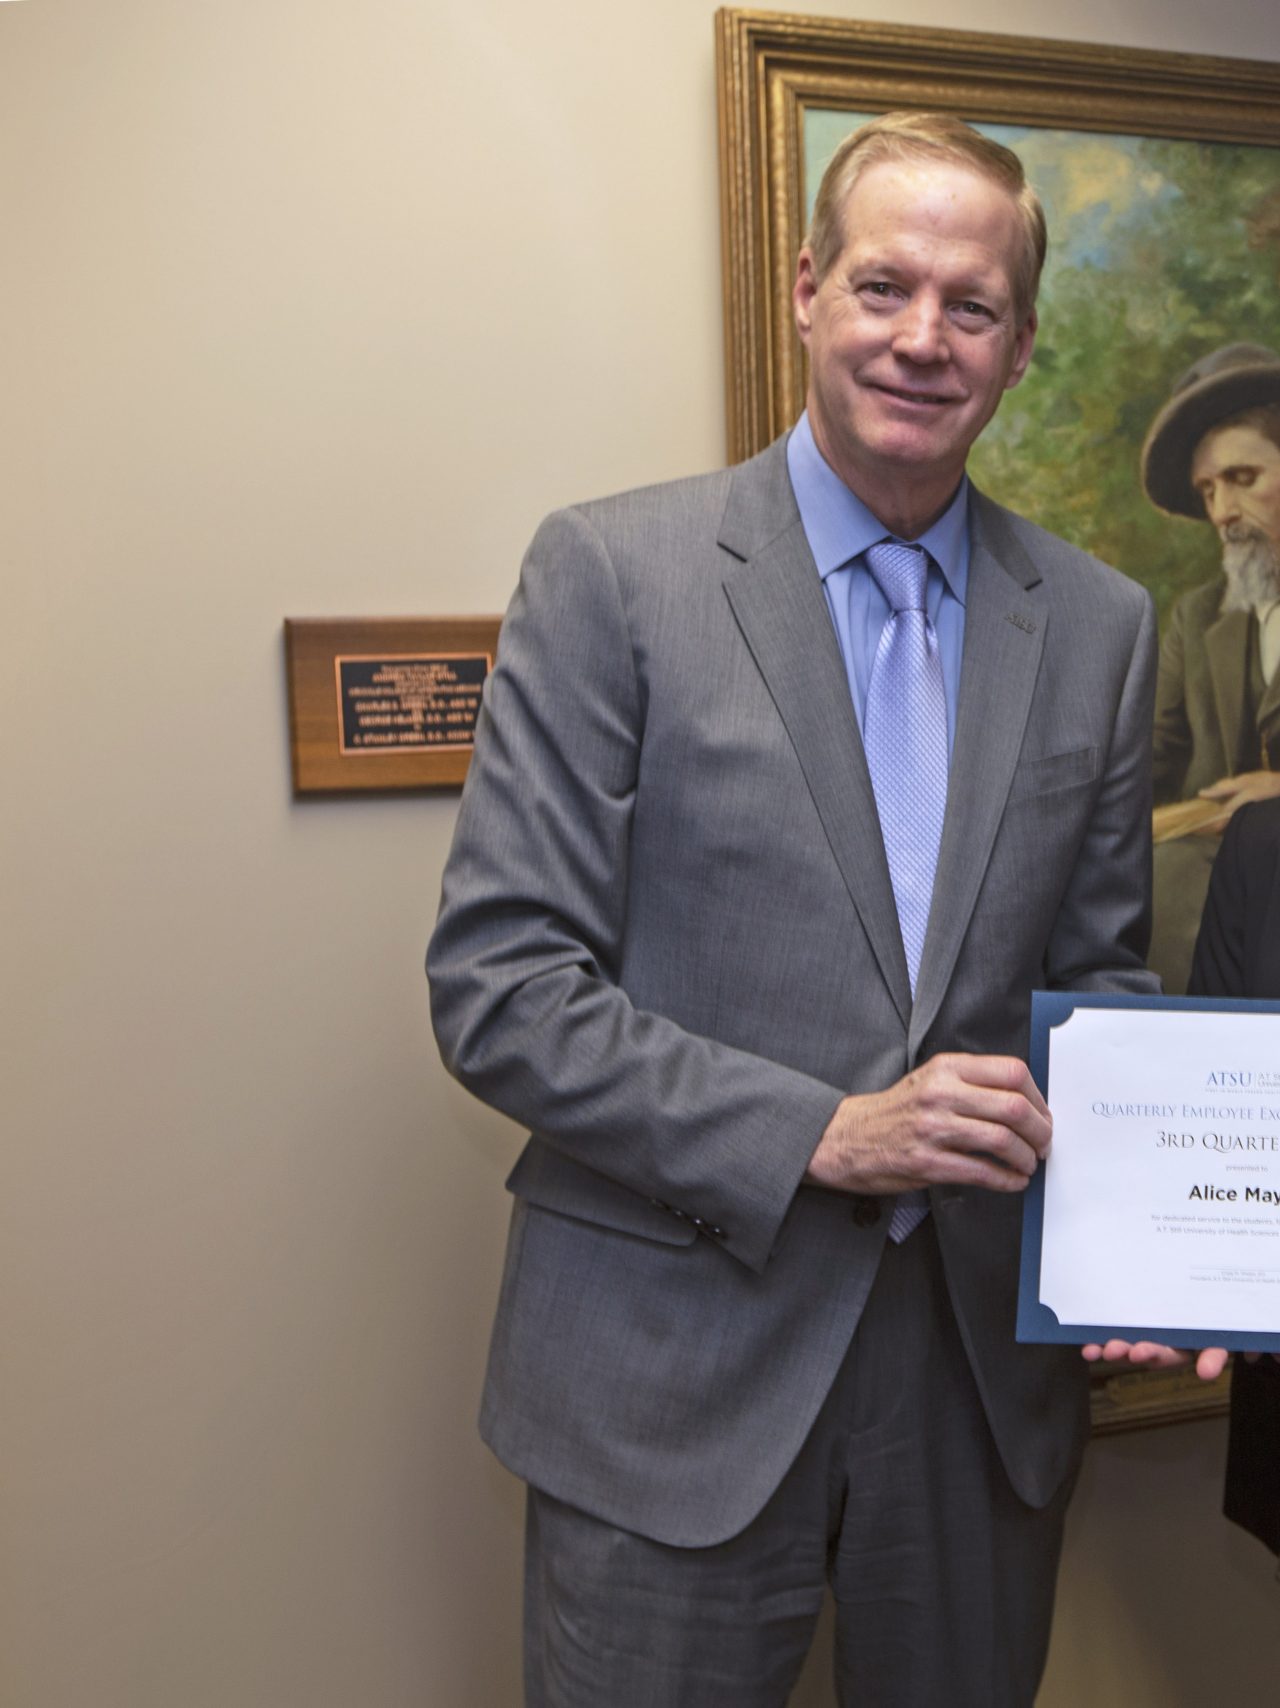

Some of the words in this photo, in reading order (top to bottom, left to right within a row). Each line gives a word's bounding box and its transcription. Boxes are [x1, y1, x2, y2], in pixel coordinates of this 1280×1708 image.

[1207, 1071, 1252, 1087] ATSU
[1092, 1101, 1177, 1118] QUARTERLY
[1182, 1103, 1256, 1120] EMPLOYEE
[1156, 1130, 1195, 1149] 3RD
[1260, 1165, 1268, 1173] to
[1188, 1184, 1237, 1202] Alice
